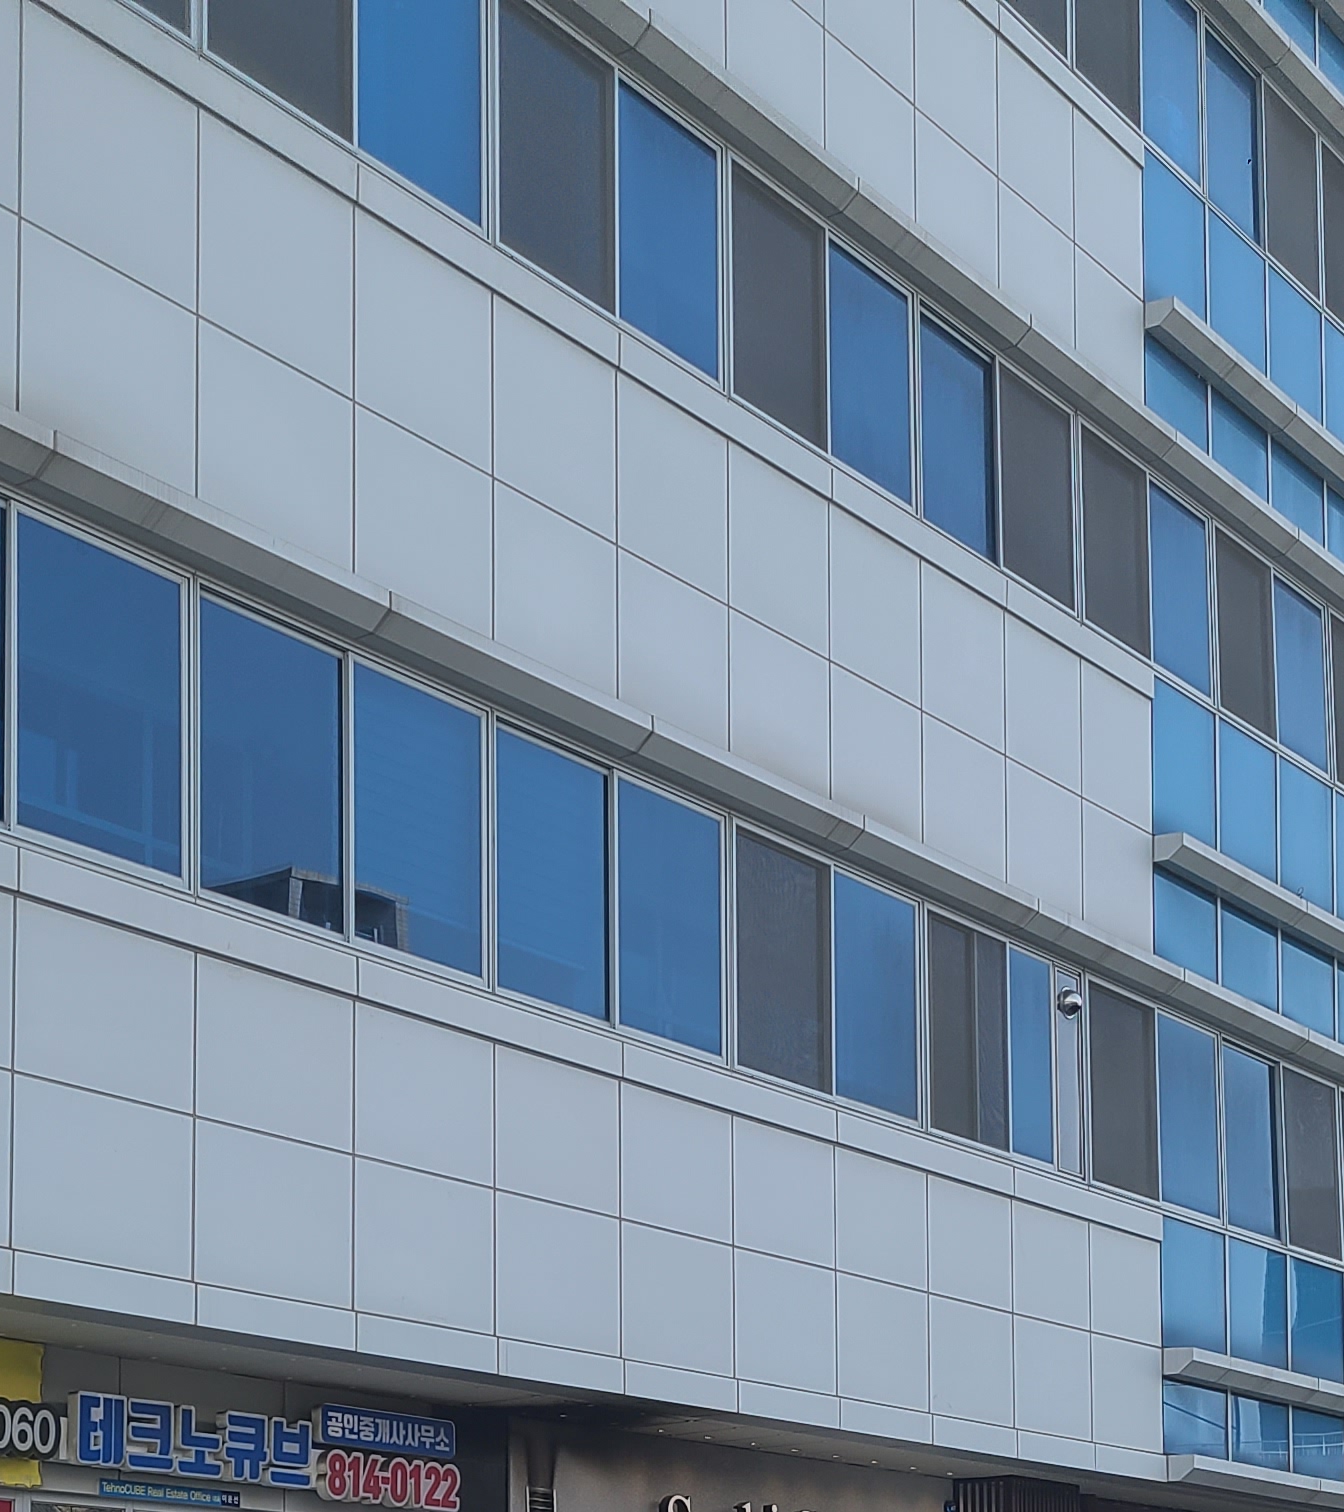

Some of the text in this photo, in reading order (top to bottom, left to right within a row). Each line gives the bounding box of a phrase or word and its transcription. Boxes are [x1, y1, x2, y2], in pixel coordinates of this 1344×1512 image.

[74, 1392, 312, 1489] 테크노큐브
[327, 1410, 451, 1453] 공인중개사사무소
[148, 1486, 164, 1497] Real
[166, 1488, 188, 1499] Estate
[190, 1490, 211, 1502] Office
[327, 1451, 460, 1512] 814-0122
